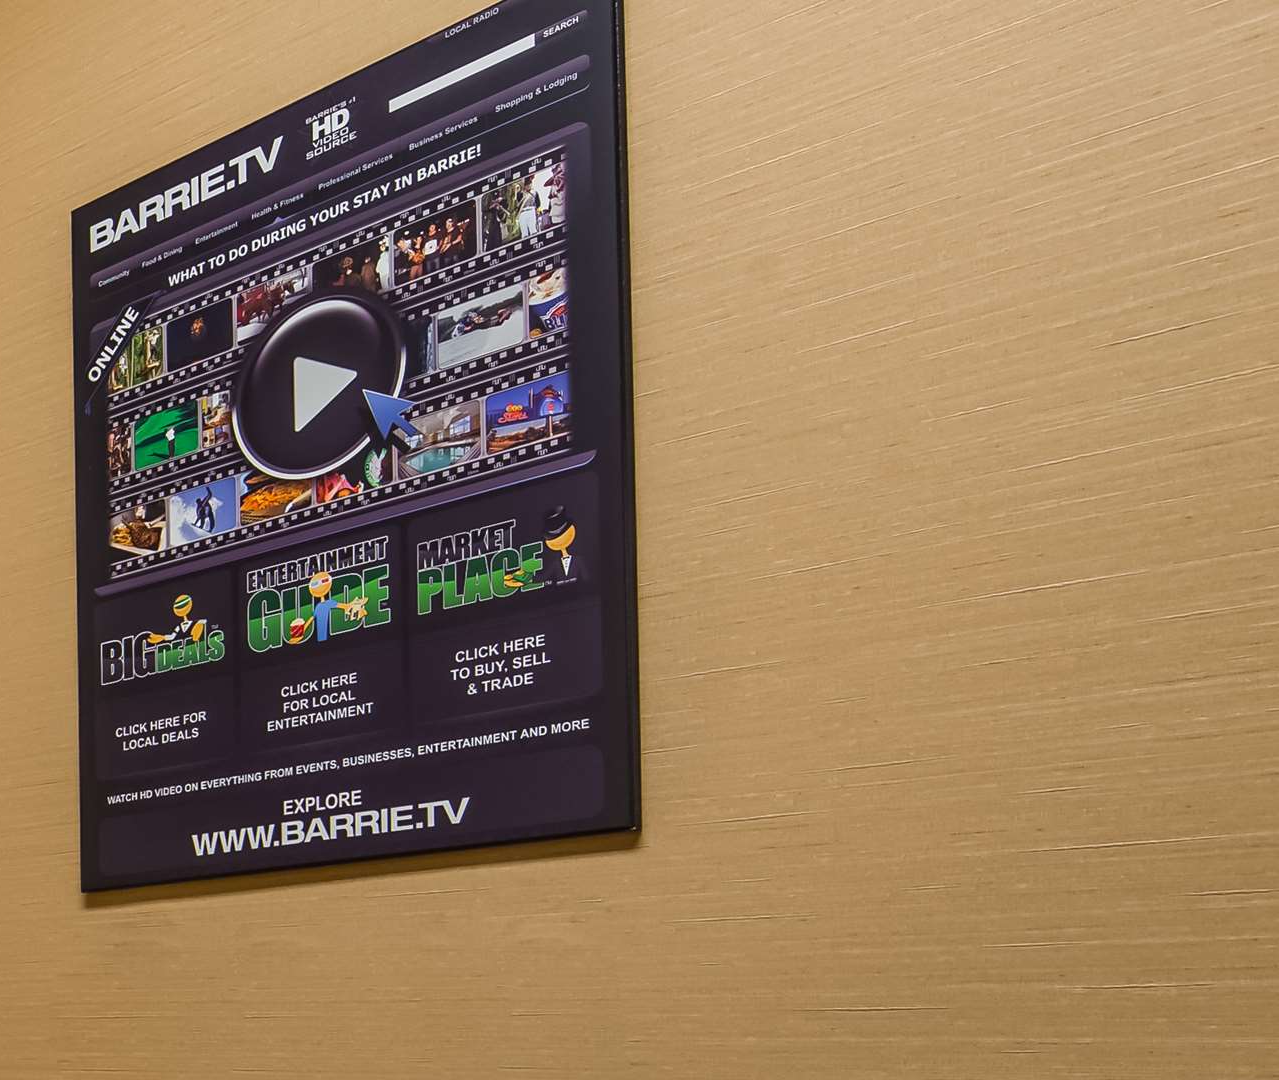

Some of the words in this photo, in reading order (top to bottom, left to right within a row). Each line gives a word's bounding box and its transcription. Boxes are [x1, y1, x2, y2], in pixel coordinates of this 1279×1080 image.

[444, 21, 472, 38] LOCAL
[473, 7, 499, 25] RADIO
[543, 16, 579, 38] SEARCH
[494, 91, 534, 113] Shopping
[535, 87, 542, 96] &
[543, 72, 578, 92] Lodging
[312, 108, 350, 142] HD
[312, 127, 349, 148] VIDEO
[408, 131, 443, 151] Business
[444, 115, 479, 136] Services
[305, 131, 357, 161] SOURCE
[318, 166, 361, 191] Professional
[361, 153, 393, 172] Services
[90, 135, 284, 254] BARRIE.TV
[168, 261, 205, 287] WHAT
[208, 253, 225, 268] TO
[229, 244, 248, 262] DO
[251, 219, 307, 252] DURING
[310, 201, 351, 227] YOUR
[353, 182, 391, 209] STAY
[394, 173, 413, 192] IN
[416, 143, 482, 183] BARRIE!
[251, 206, 272, 220] Health
[195, 221, 238, 245] Entertainment
[141, 257, 157, 269] Food
[163, 246, 183, 260] Dining
[98, 268, 130, 287] Community
[87, 306, 140, 383] ONLINE
[416, 519, 516, 571] MARKET
[246, 535, 389, 593] ENTERTAINMENT
[417, 541, 545, 617] PLACE
[100, 631, 157, 686] BIG
[155, 622, 226, 674] DEALS
[454, 642, 499, 664] CLICK
[503, 634, 546, 654] HERE
[450, 666, 471, 682] TO
[474, 657, 509, 678] BUY,
[513, 651, 551, 672] SELL
[280, 680, 319, 699] CLICK
[324, 672, 359, 690] HERE
[467, 682, 478, 696] &
[481, 672, 534, 694] TRADE
[267, 702, 374, 733] ENTERTAINMENT
[283, 698, 309, 714] FOR
[312, 690, 356, 708] LOCAL
[115, 722, 148, 738] CLICK
[149, 716, 181, 732] HERE
[183, 710, 207, 726] FOR
[122, 735, 159, 752] LOCAL
[161, 727, 199, 744] DEALS
[107, 792, 138, 805] WATCH
[139, 789, 153, 801] HD
[154, 785, 183, 798] VIDEO
[184, 782, 199, 794] ON
[200, 772, 263, 792] EVERYTHING
[264, 767, 293, 780] FROM
[296, 759, 341, 776] EVENTS,
[343, 747, 415, 768] BUSINESSES,
[417, 730, 518, 756] ENTERTAINMENT
[520, 725, 548, 740] AND
[551, 718, 591, 735] MORE
[283, 789, 362, 816] EXPLORE
[191, 796, 471, 857] WWW.BARRIE.TV
